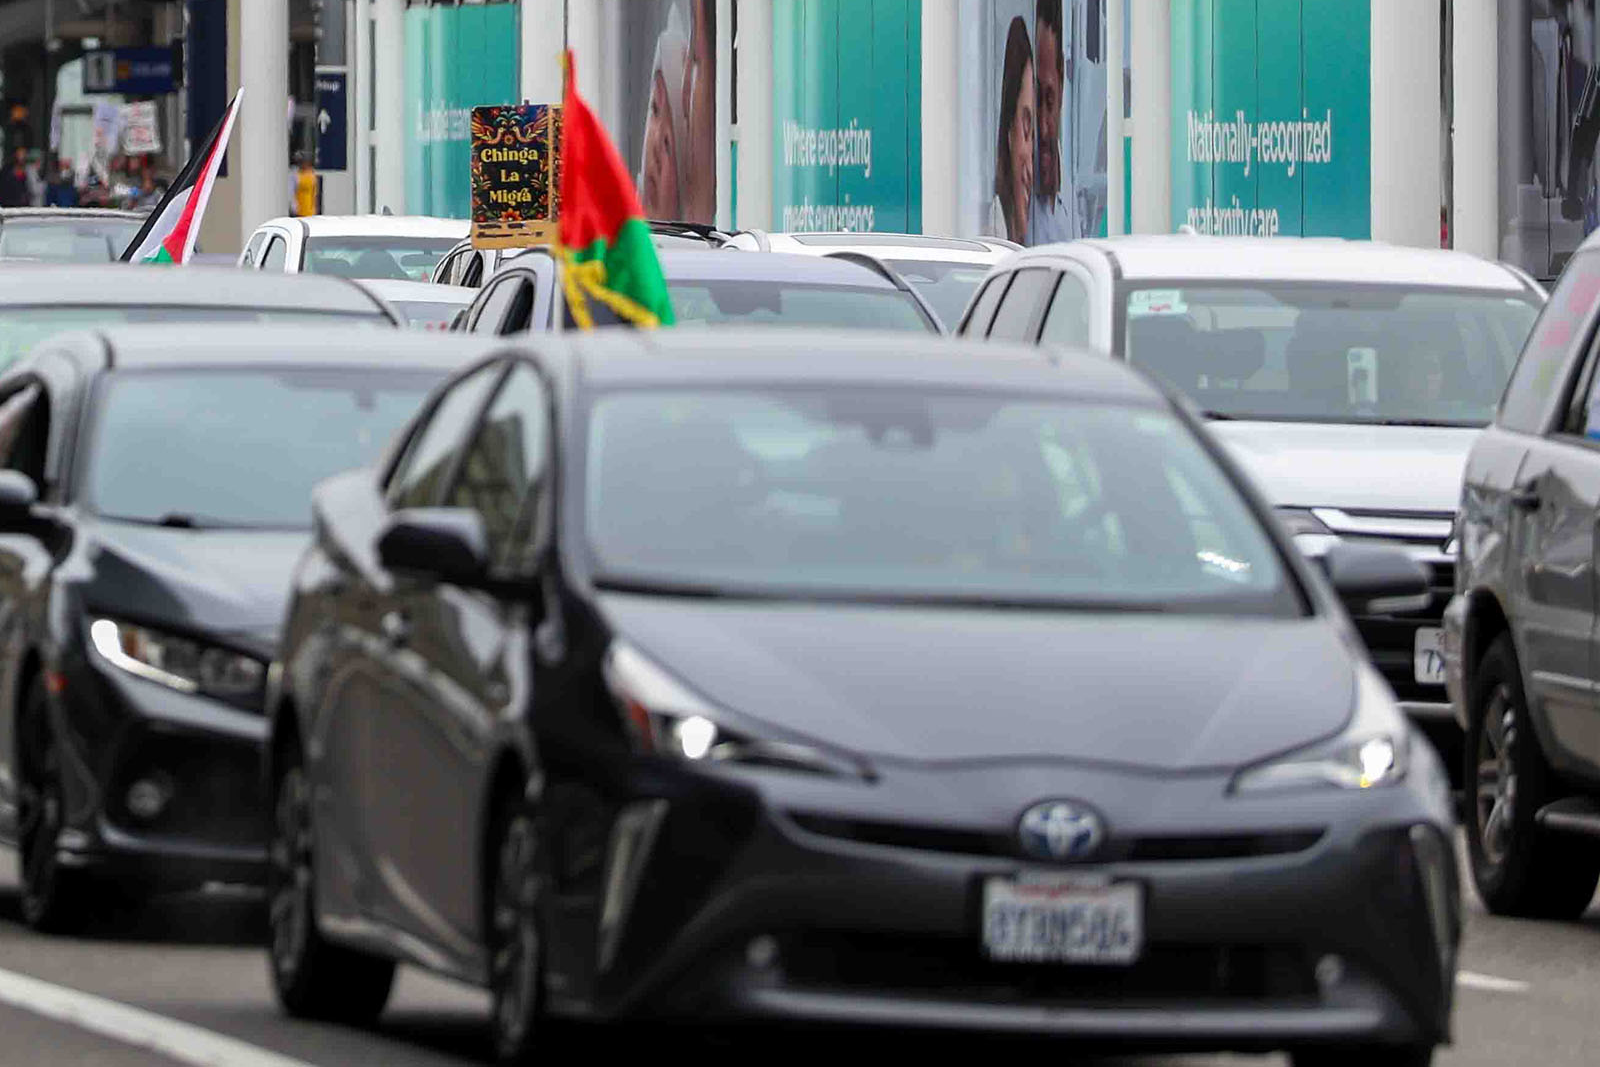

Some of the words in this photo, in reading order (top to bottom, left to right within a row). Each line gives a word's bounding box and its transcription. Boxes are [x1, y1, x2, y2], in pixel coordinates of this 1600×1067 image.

[480, 147, 539, 165] Chinga
[782, 117, 817, 166] Where
[818, 117, 872, 178] expecting
[1186, 106, 1332, 177] Nationally-recognized
[501, 169, 520, 183] La
[782, 195, 814, 233] meets
[815, 193, 875, 233] experience
[1186, 194, 1249, 238] maternity
[1250, 207, 1279, 238] care
